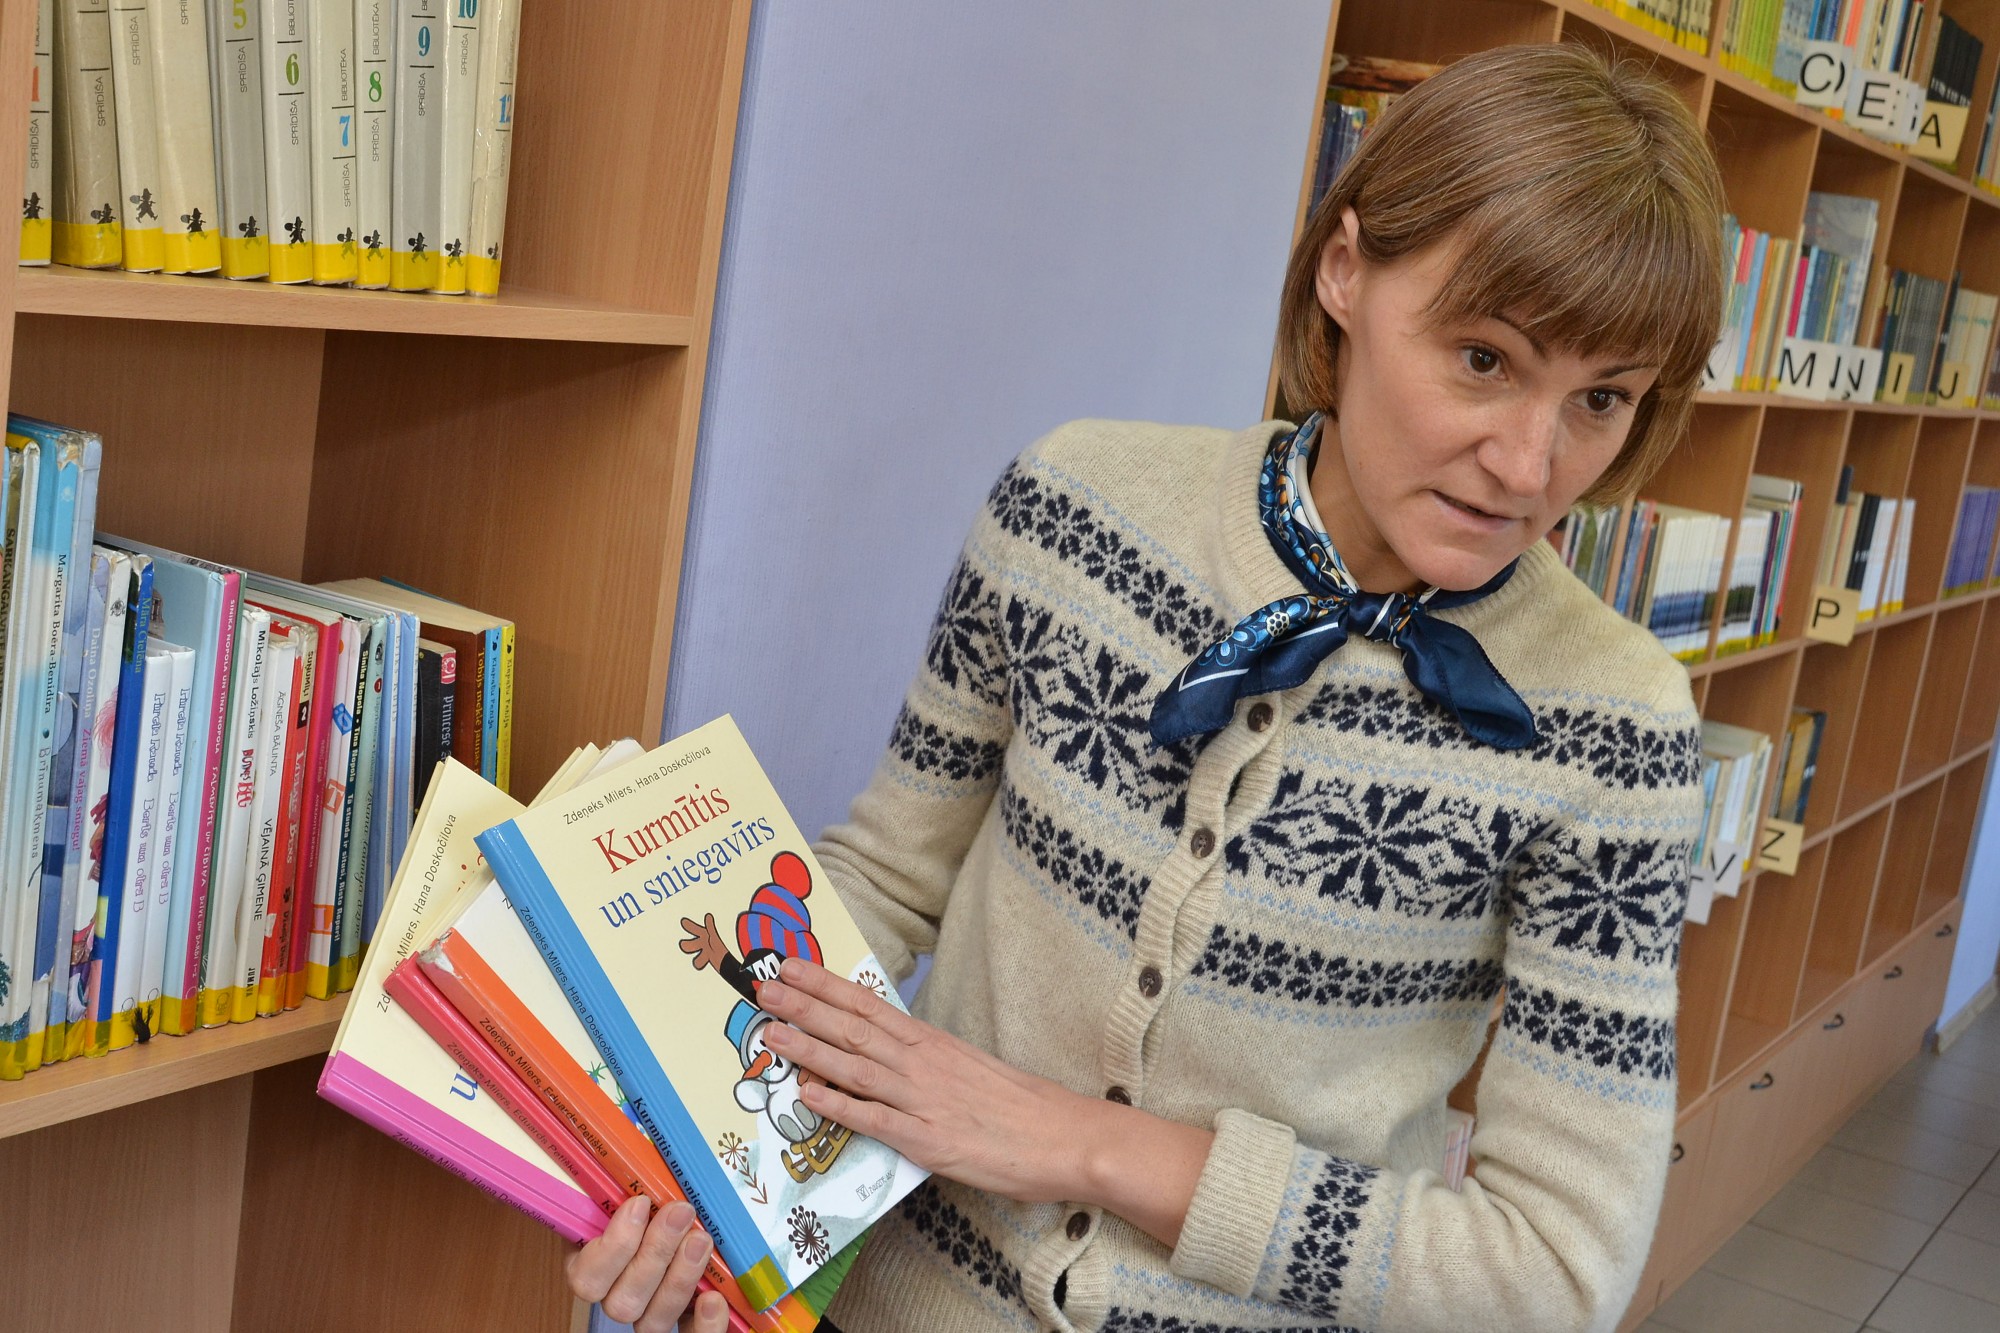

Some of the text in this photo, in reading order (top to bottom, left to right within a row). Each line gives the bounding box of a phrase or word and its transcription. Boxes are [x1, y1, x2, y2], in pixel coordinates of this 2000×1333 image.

[233, 0, 247, 30] 5
[372, 2, 380, 56] BIBLIOTĒKA
[129, 16, 141, 66] SPRĪDĪŠA
[418, 25, 431, 57] 9
[461, 33, 469, 76] SPRĪDĪŠA
[238, 46, 247, 93] SPRĪDĪŠA
[285, 53, 300, 86] 6
[339, 48, 347, 101] BIBLIOTĒKA
[368, 70, 382, 103] 8
[1800, 53, 1835, 93] C
[96, 76, 106, 127] SPRĪDĪŠA
[418, 72, 426, 117] SPRĪDĪŠA
[1857, 81, 1890, 120] E
[30, 118, 39, 169] SPRĪDĪŠA
[289, 100, 298, 146] SPRĪDĪŠA
[339, 115, 350, 147] 7
[372, 117, 380, 162] SPRĪDĪŠA
[1918, 113, 1942, 148] A
[343, 162, 351, 208] SPRĪDĪŠA
[1779, 348, 1816, 387] M
[1938, 371, 1959, 399] J
[52, 553, 66, 616] Margarita
[226, 599, 235, 630] SINIKA
[1809, 597, 1841, 628] P
[222, 633, 232, 672] NOPOLA
[251, 629, 266, 684] Mikolajs
[359, 649, 368, 678] Sinika
[475, 647, 485, 687] Tobijs
[82, 667, 97, 718] Ozoliņa
[220, 674, 227, 688] UN
[354, 680, 365, 715] Nopola
[213, 715, 224, 753] NOPOLA
[245, 686, 260, 740] Ložiņskis
[79, 726, 92, 766] Ziemā
[347, 749, 358, 782] Nopola
[29, 747, 50, 858] Brīnumakmens
[74, 769, 87, 803] vajag
[251, 691, 286, 920] ĀGNEŠA BĀLINTA VĒJAINĀ ĢIMENE
[563, 746, 711, 825] Zdeņeks Milers, Hana Doskočilova
[70, 805, 84, 849] sniegu!
[343, 807, 352, 837] stunda
[592, 783, 731, 874] Kurmītis
[341, 840, 349, 848] ir
[1760, 827, 1785, 862] Z
[336, 881, 344, 905] Risto
[397, 919, 420, 958] Milers,
[413, 886, 431, 915] Hana
[424, 814, 457, 883] Doskočilova
[599, 816, 776, 929] un sniegavīrs
[479, 1017, 516, 1057] Zdeņeks
[515, 1055, 542, 1091] Milers,
[543, 1086, 578, 1125] Eduards
[577, 1123, 608, 1158] Petiška
[520, 906, 549, 950] Zdeņeks
[546, 951, 568, 986] Milers,
[567, 986, 587, 1014] Hana
[585, 1014, 624, 1076] Doskočilova
[633, 1097, 673, 1158] Kurmītis
[670, 1159, 684, 1177] un
[681, 1179, 725, 1247] sniegavīrs
[447, 1041, 580, 1176] Zdeņeks Milers, Eduards Petiška
[470, 1176, 497, 1197] Hana
[499, 1193, 557, 1231] Doskočilova
